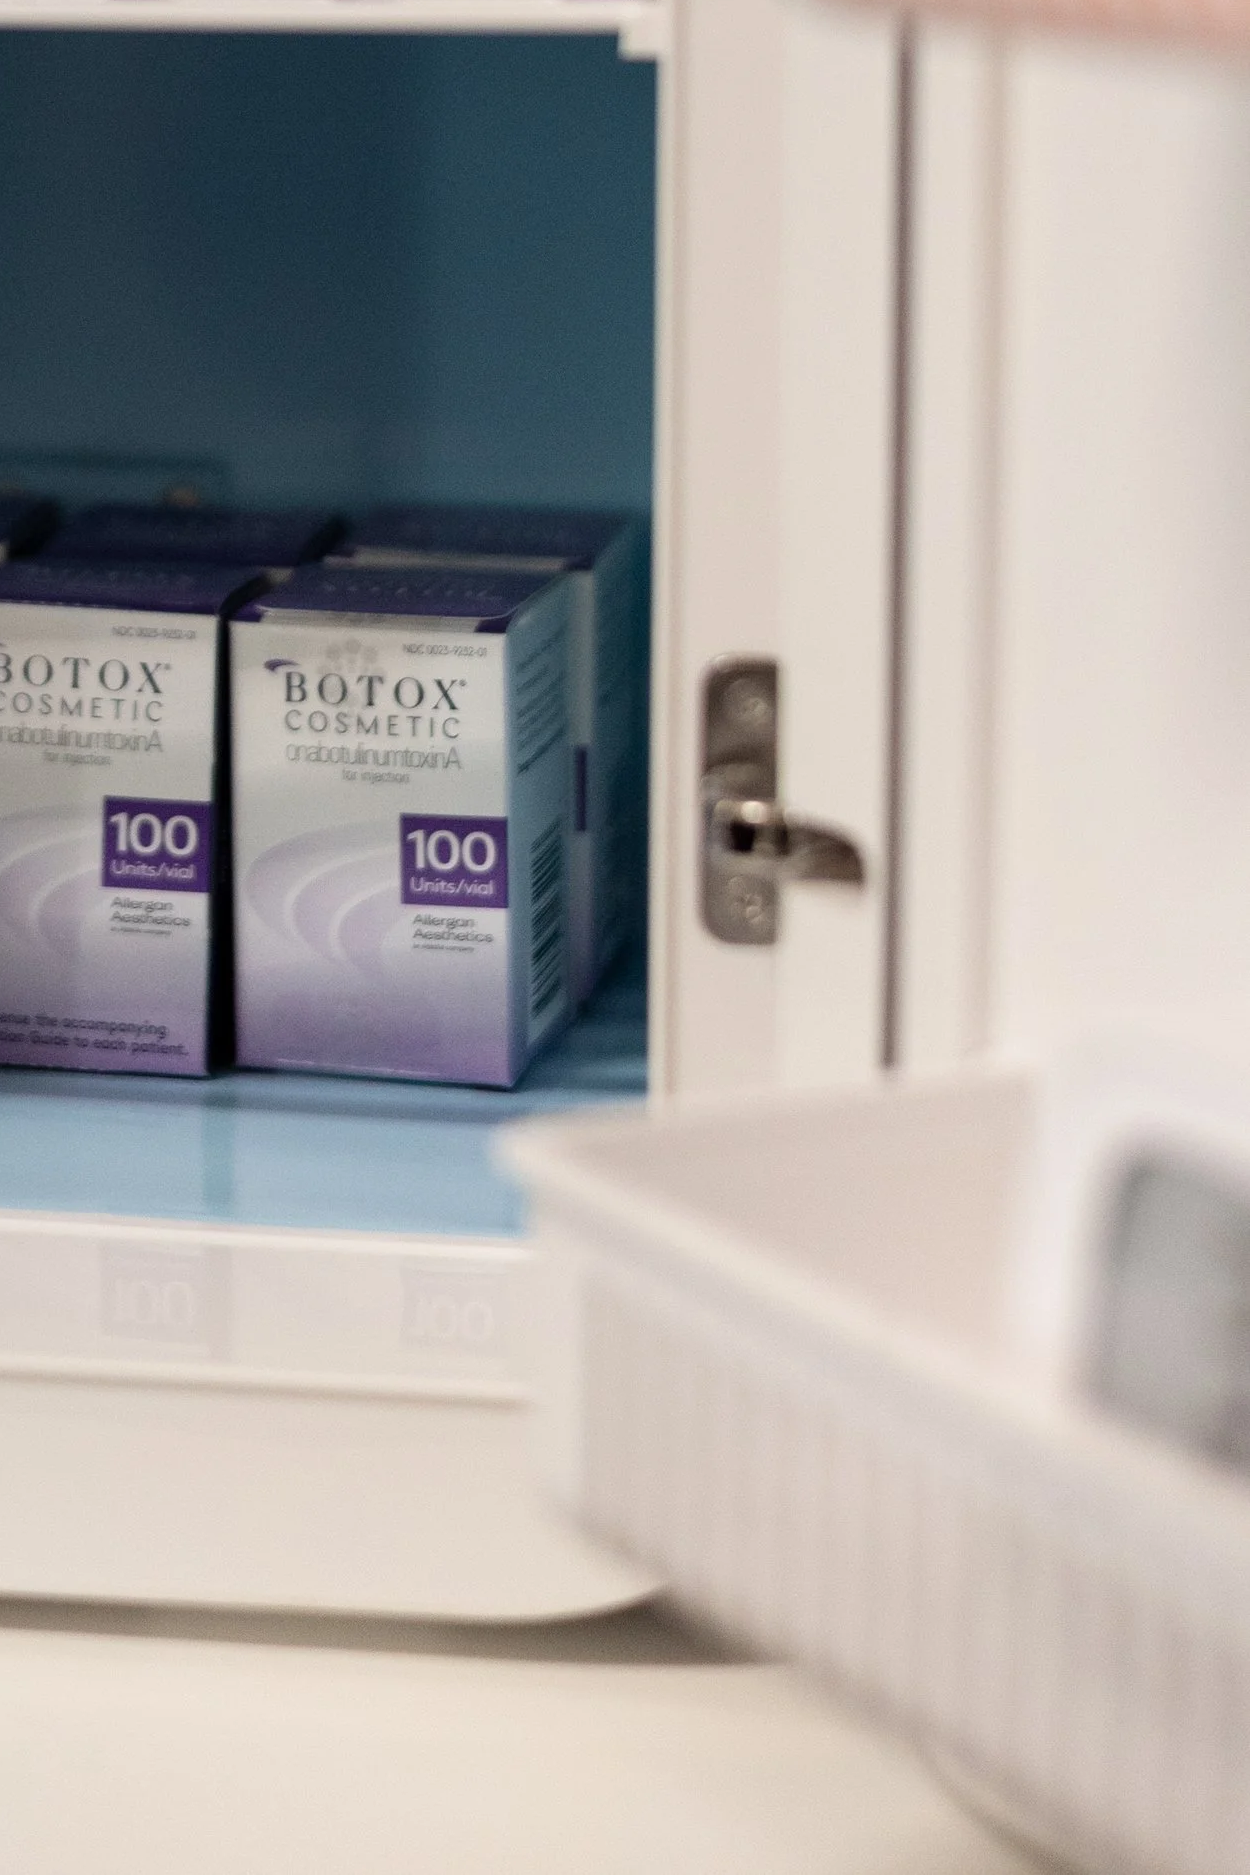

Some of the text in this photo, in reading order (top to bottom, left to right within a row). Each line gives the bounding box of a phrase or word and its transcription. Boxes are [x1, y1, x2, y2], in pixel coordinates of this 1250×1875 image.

[284, 709, 460, 739] COSMETIC
[285, 741, 463, 770] onabotulinumtoxinA
[109, 810, 199, 857] 100
[406, 829, 497, 873] 100
[111, 859, 196, 879] Units/vial
[409, 875, 495, 896] Units/vial
[412, 913, 476, 929] Allergan
[412, 928, 494, 943] Aesthetics
